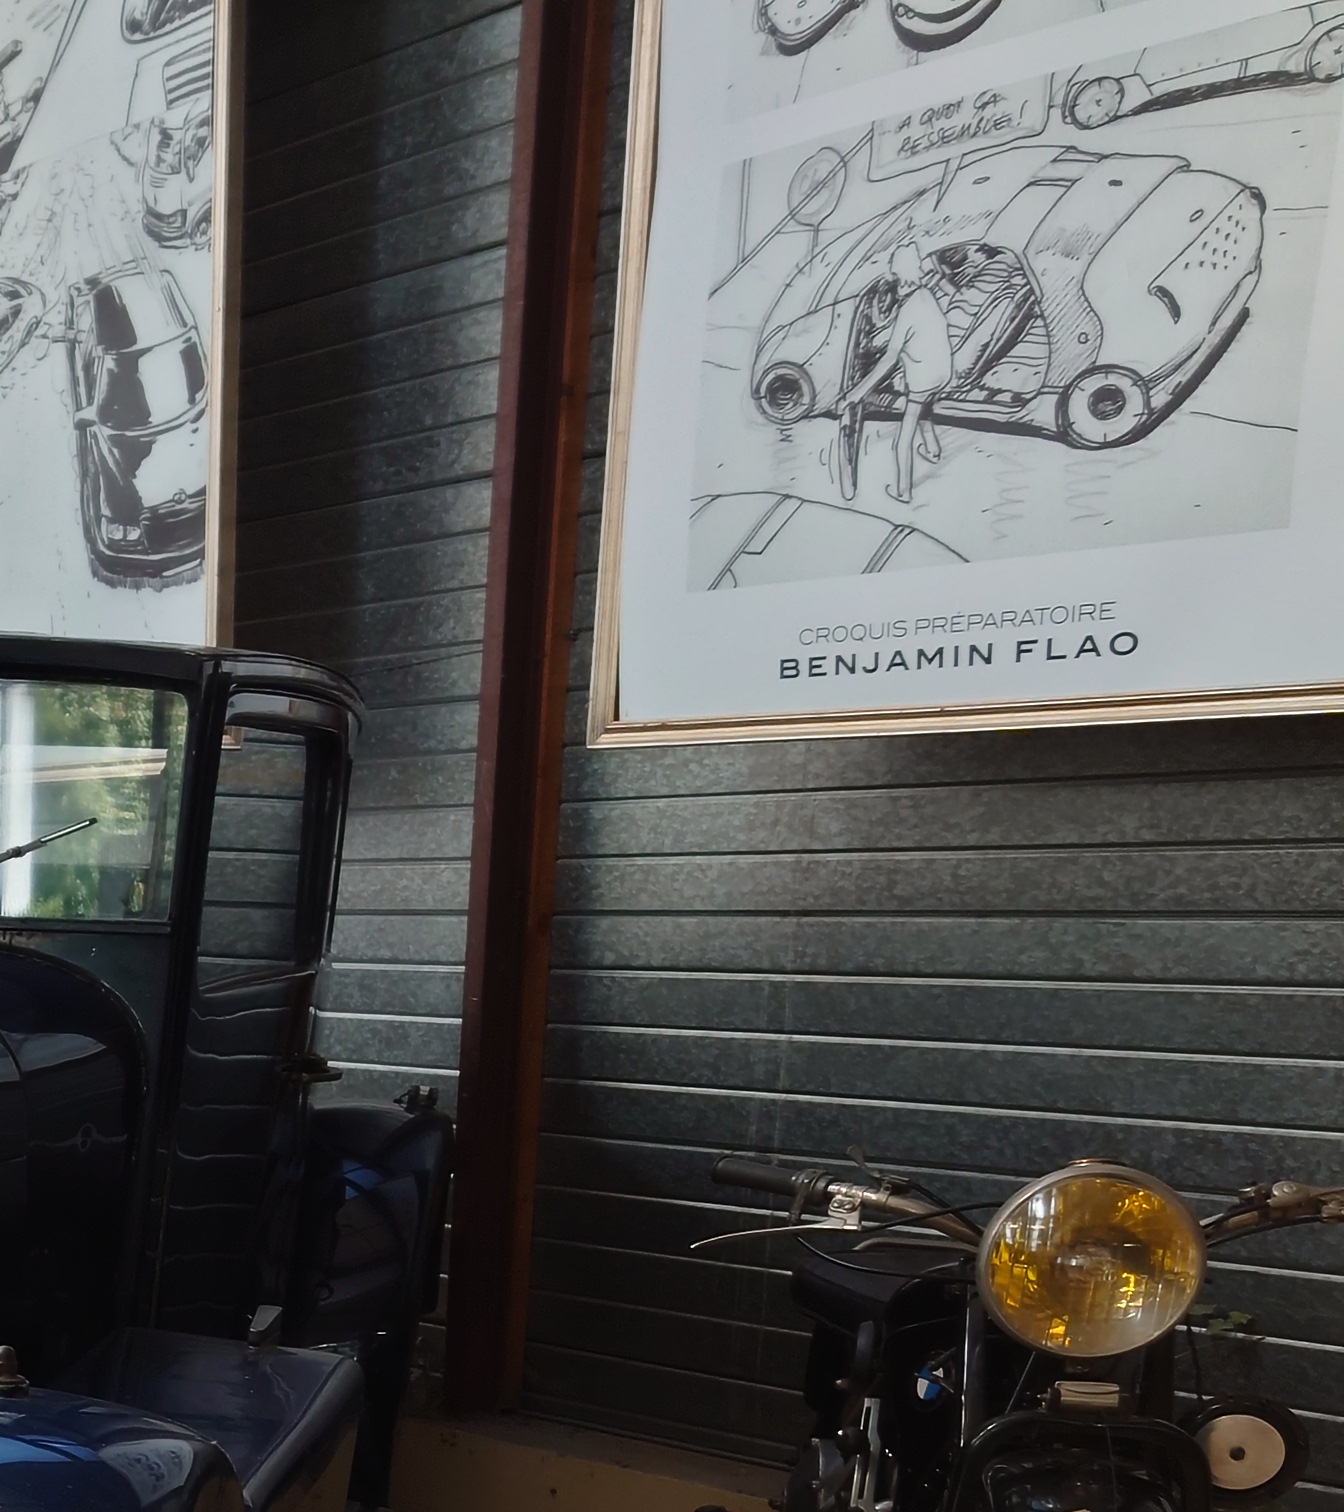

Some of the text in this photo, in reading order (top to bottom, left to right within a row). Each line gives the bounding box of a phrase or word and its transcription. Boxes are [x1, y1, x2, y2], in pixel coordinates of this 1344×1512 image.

[798, 598, 1118, 648] CROQUIS PRÉPARATOIRE
[778, 631, 1141, 679] BENJAMIN FLAO
